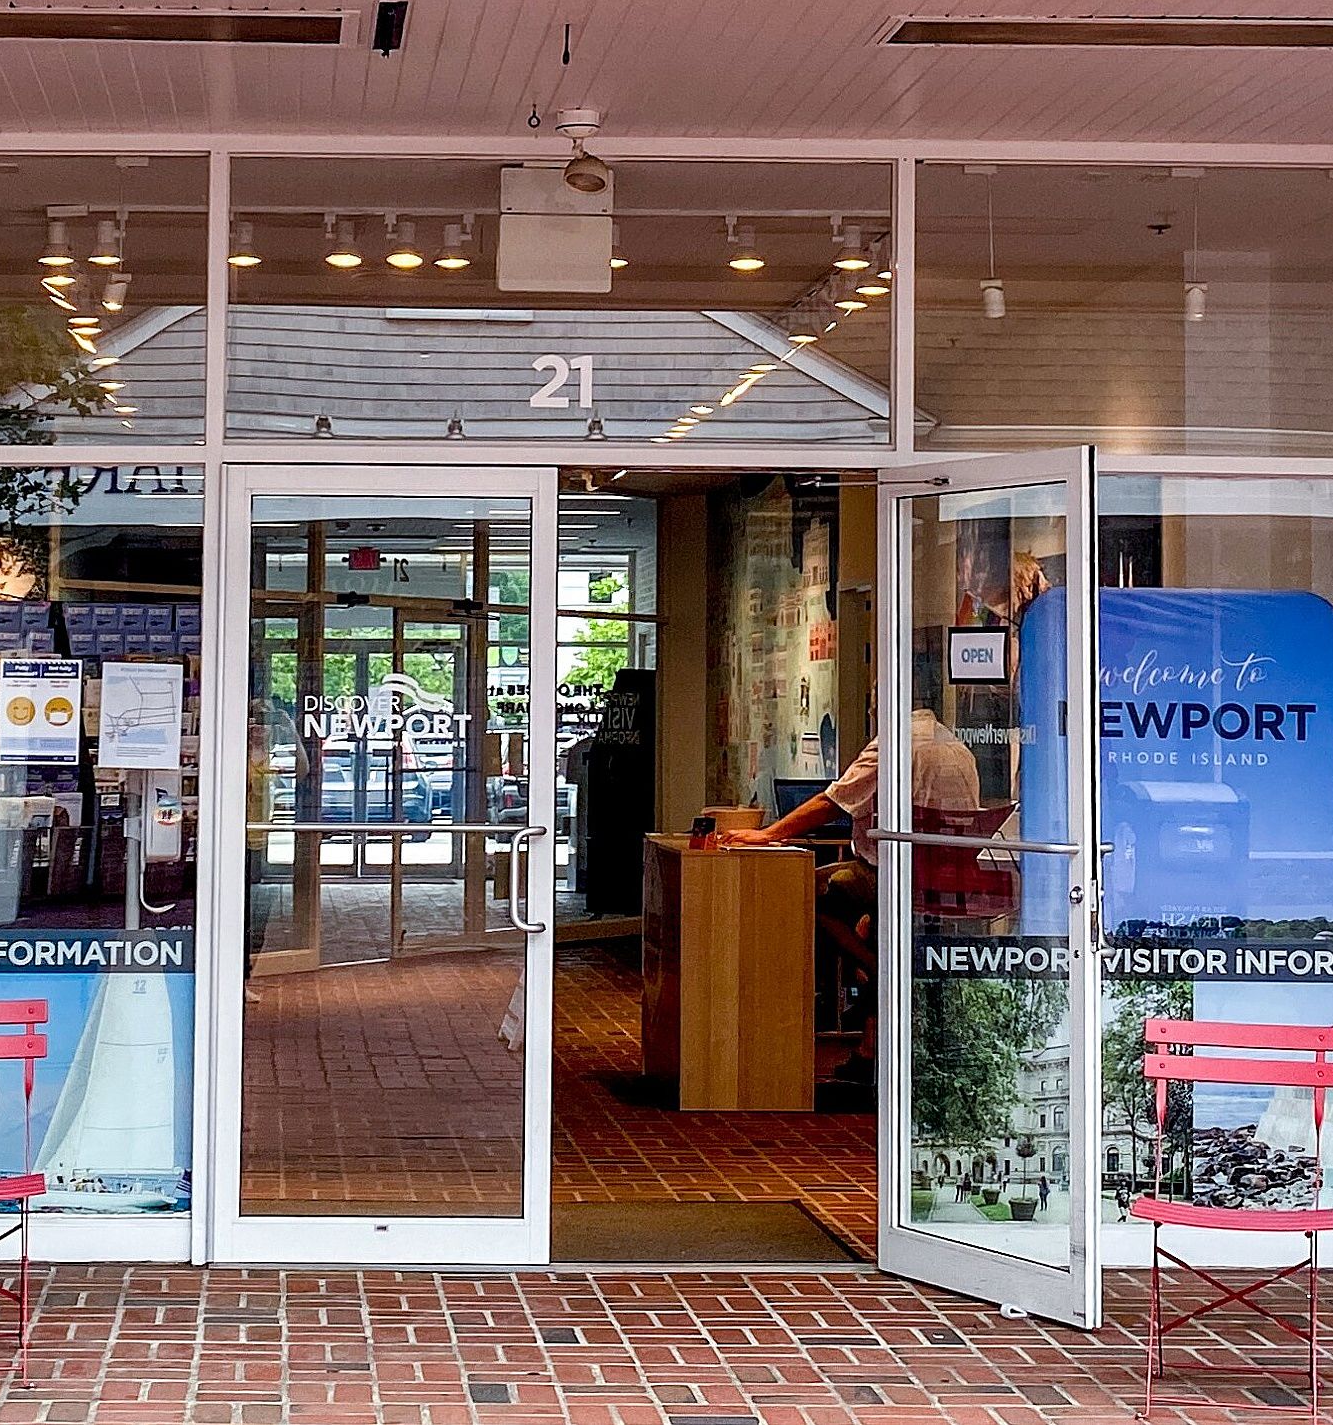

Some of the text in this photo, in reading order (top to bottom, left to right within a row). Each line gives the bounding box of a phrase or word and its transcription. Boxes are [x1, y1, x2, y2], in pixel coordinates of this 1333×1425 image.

[530, 355, 592, 408] 21
[961, 648, 993, 663] OPEN
[1099, 649, 1277, 696] welcome to
[303, 695, 401, 712] DISCOVER
[303, 713, 472, 739] NEWPORT
[1108, 751, 1269, 766] RHODE ISLAND
[925, 946, 1069, 972] NEWPOR
[1104, 947, 1227, 974] VISITOR
